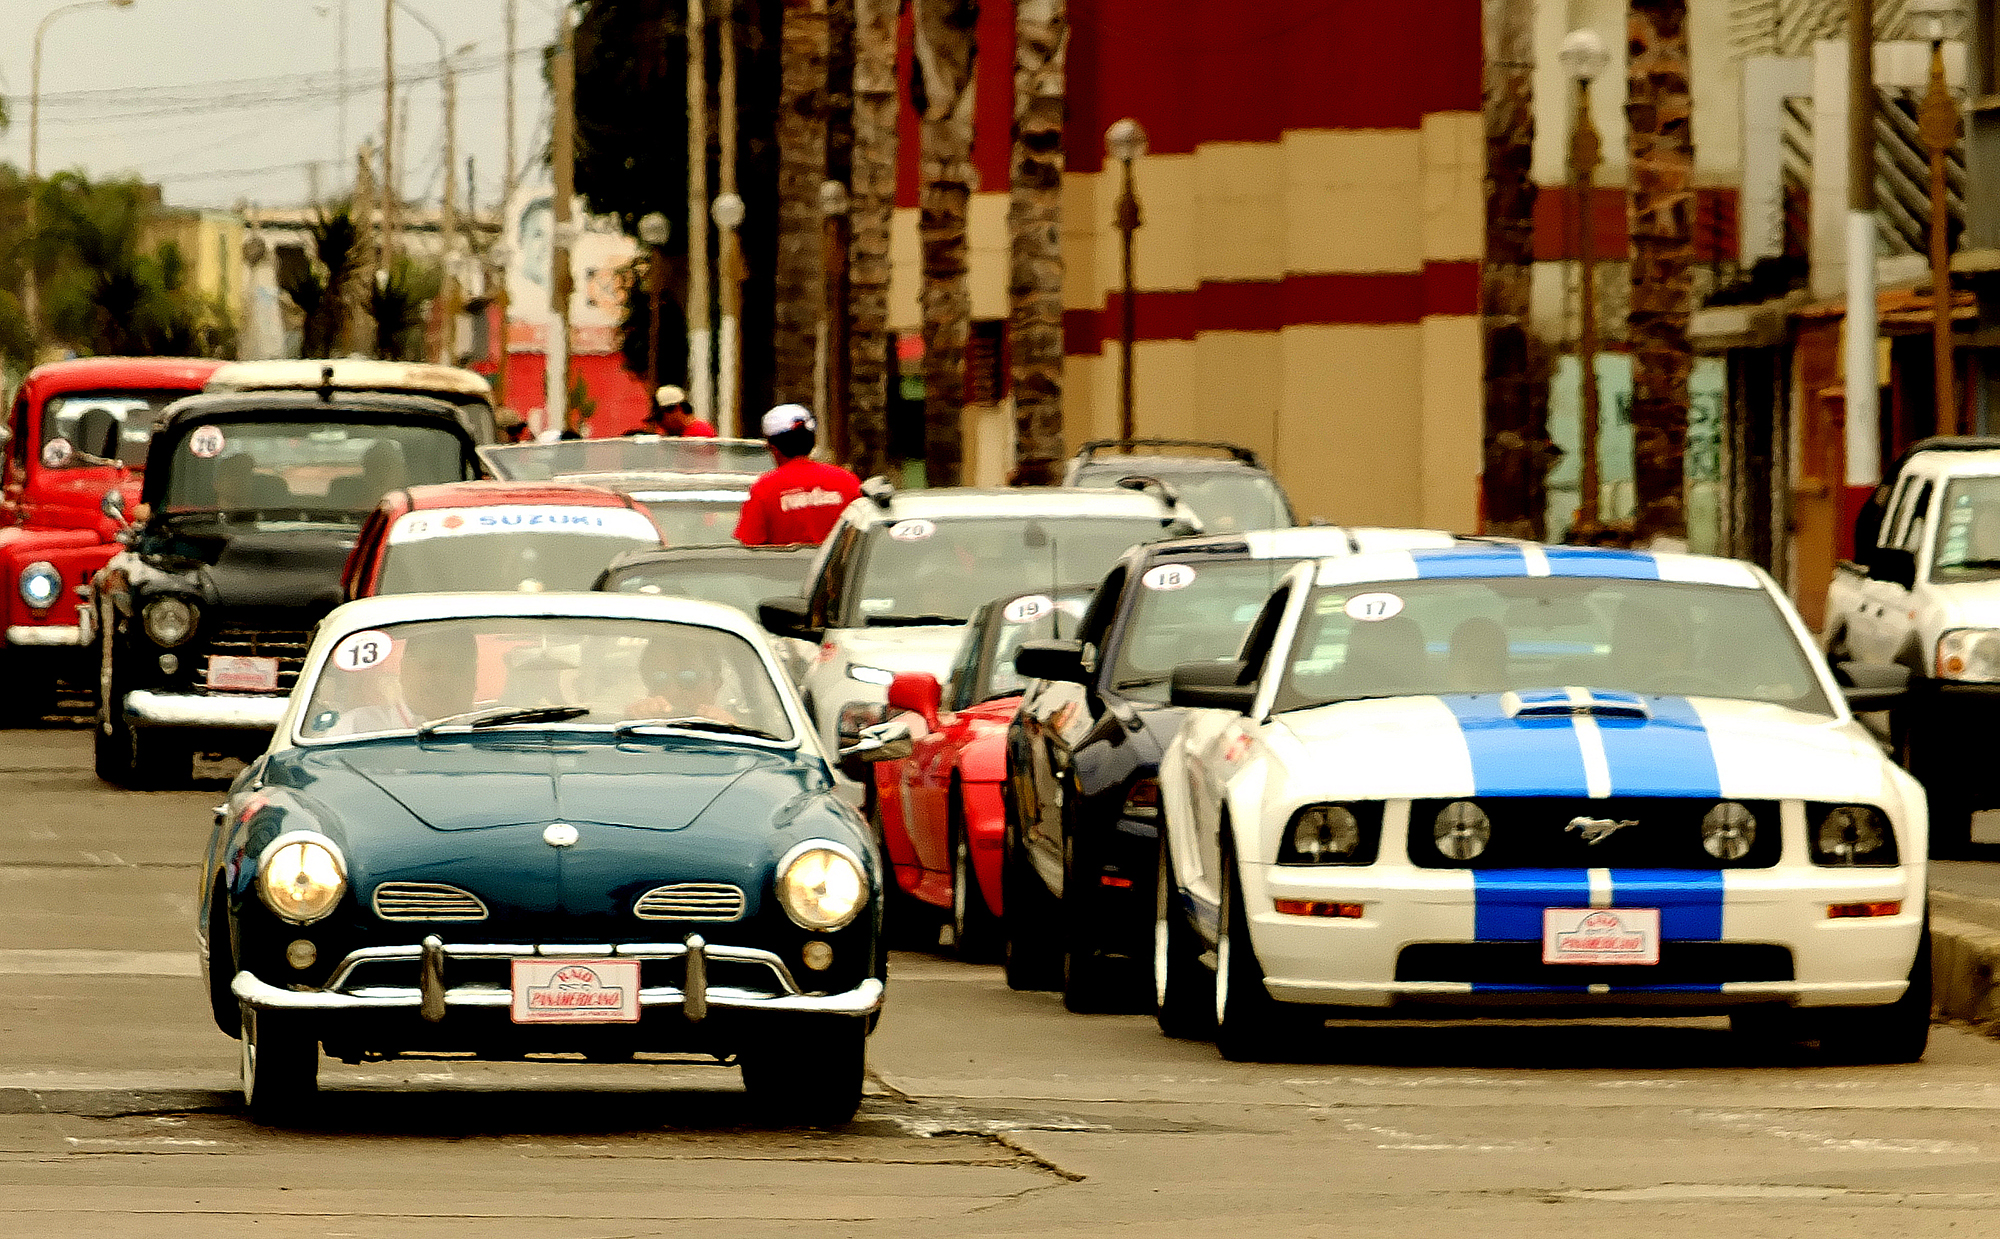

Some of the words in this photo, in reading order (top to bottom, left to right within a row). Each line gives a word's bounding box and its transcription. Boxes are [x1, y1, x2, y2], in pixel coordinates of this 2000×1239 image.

[478, 513, 603, 527] SUZUKI
[899, 524, 925, 536] 20
[1159, 571, 1181, 586] 18
[1018, 601, 1040, 617] 19
[1366, 600, 1387, 615] 17
[348, 642, 379, 666] 13
[531, 991, 620, 1007] PANAMERICANO
